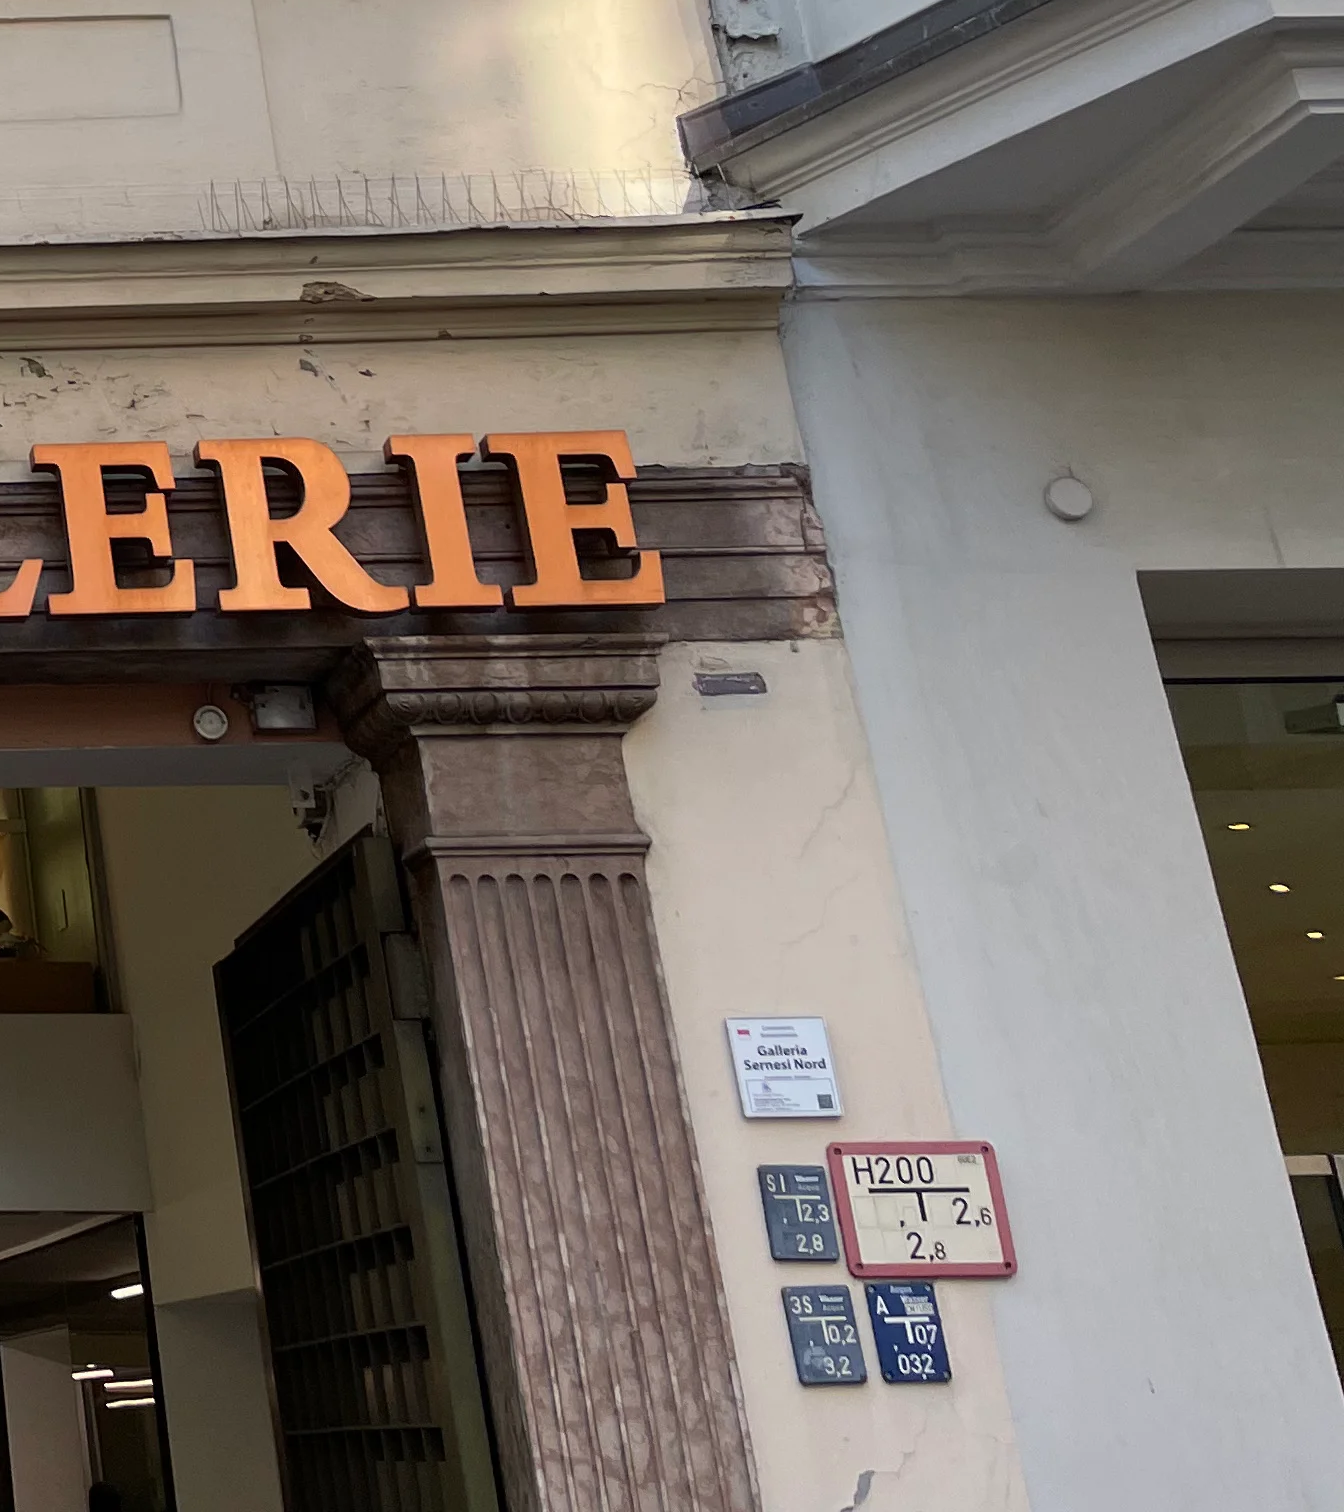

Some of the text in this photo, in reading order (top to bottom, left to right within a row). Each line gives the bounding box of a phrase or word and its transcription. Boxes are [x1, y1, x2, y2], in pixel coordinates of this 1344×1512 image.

[757, 1045, 808, 1057] Galleria
[743, 1058, 827, 1071] Sernesi Nord
[851, 1156, 934, 1185] H200
[951, 1197, 993, 1228] 2,6
[906, 1231, 947, 1262] 2,8
[876, 1295, 890, 1315] A
